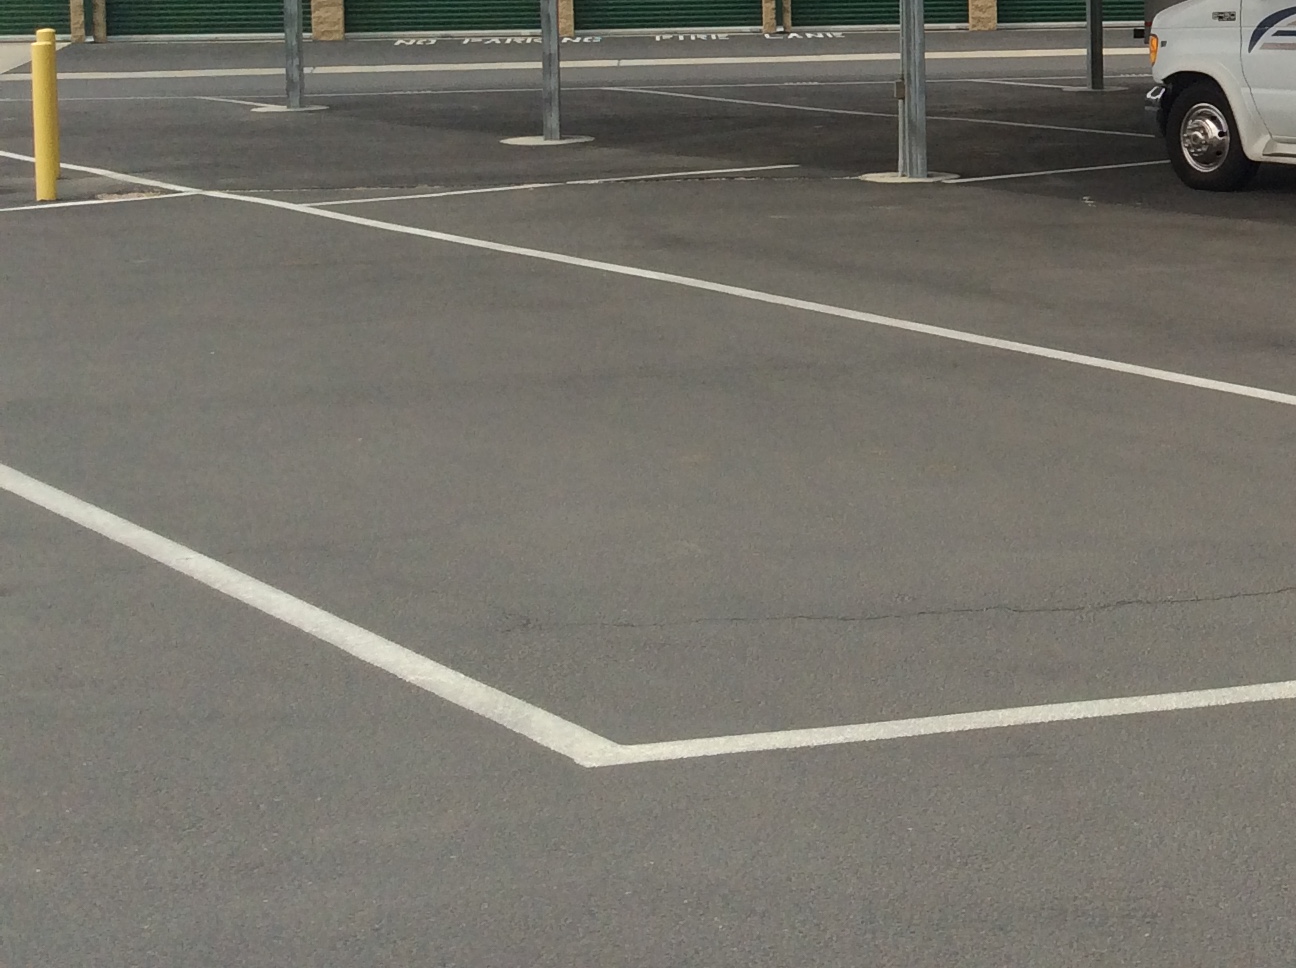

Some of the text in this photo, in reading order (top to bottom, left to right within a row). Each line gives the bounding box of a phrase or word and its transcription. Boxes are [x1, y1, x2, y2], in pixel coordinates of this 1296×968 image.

[394, 37, 438, 46] NO
[462, 36, 603, 44] PARKNG
[764, 32, 846, 40] LANE
